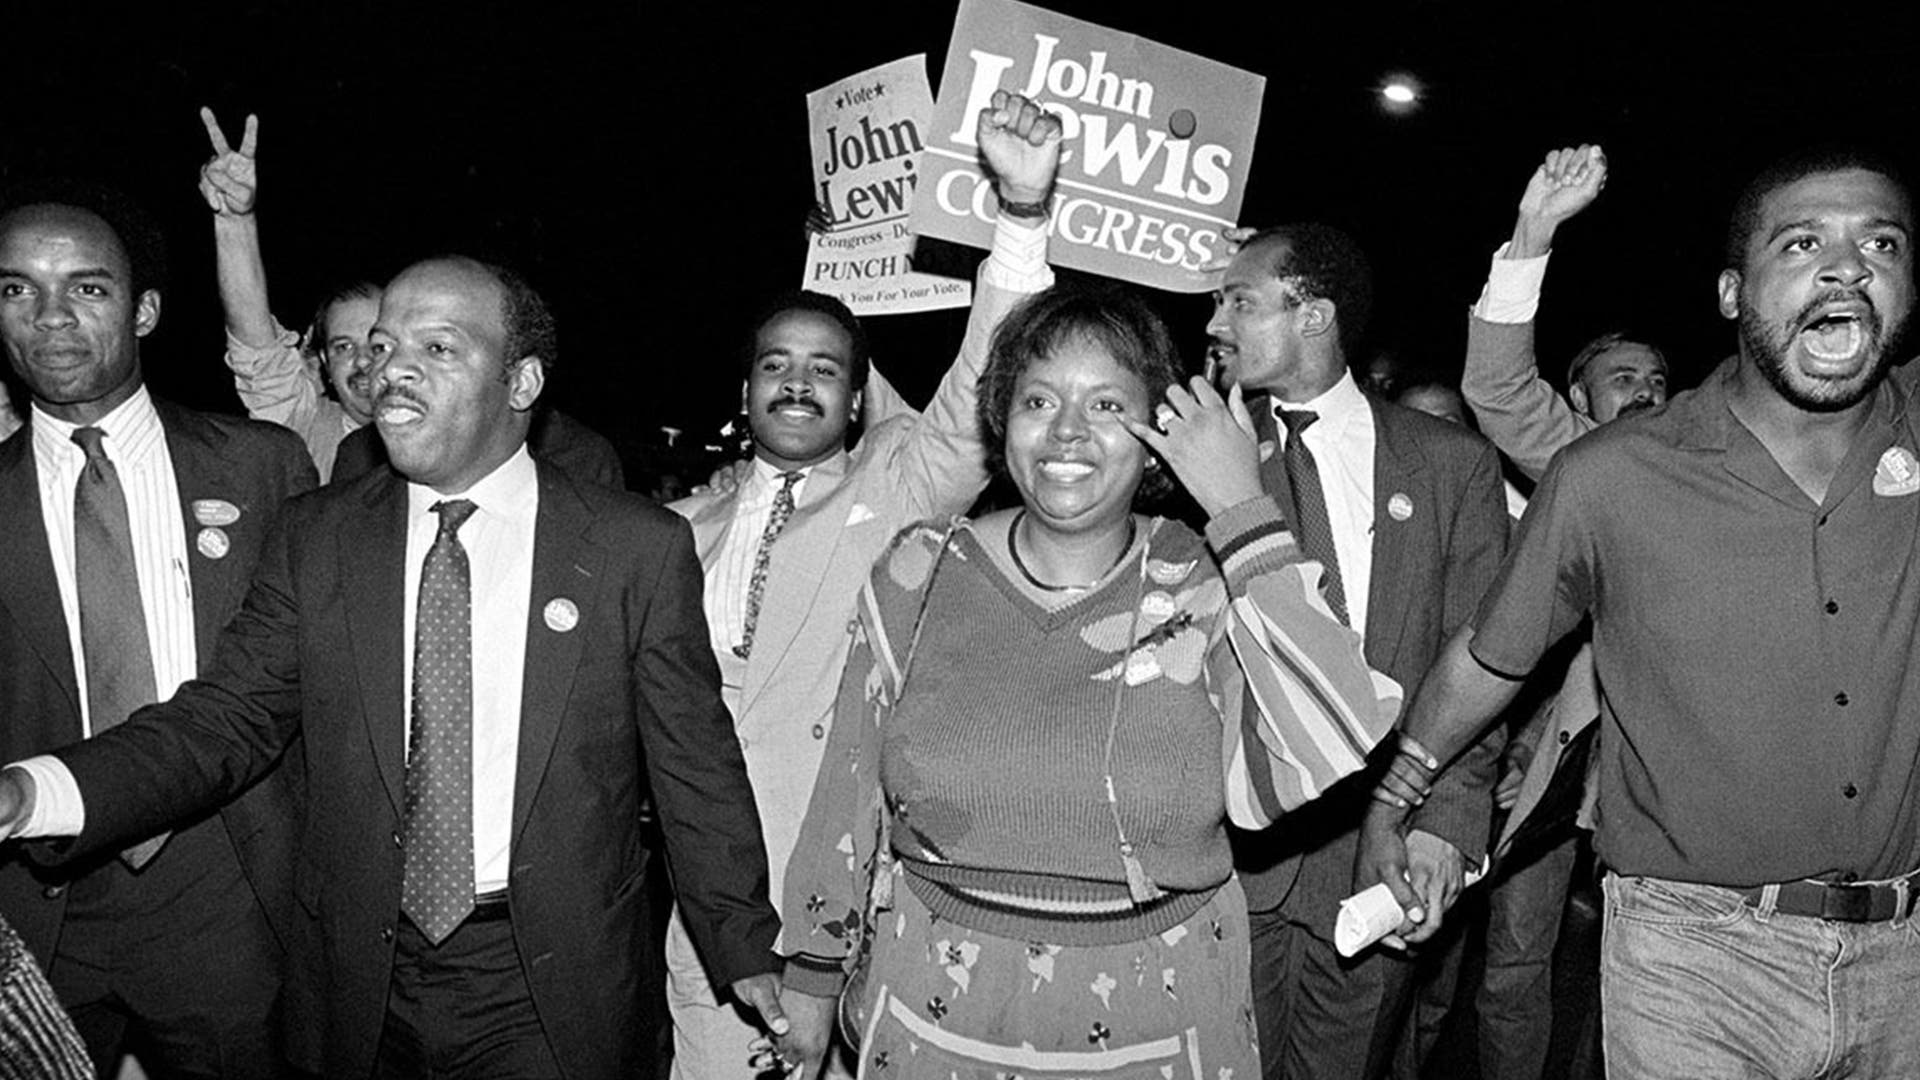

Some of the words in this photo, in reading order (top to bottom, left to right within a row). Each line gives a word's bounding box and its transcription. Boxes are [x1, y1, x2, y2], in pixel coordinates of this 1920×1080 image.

[1019, 33, 1154, 119] John
[844, 87, 873, 106] Vote
[824, 115, 925, 176] John
[814, 256, 896, 281] PUNCH
[850, 292, 874, 303] You
[876, 291, 898, 302] For
[902, 287, 930, 300] Your
[933, 283, 964, 295] Vote.
